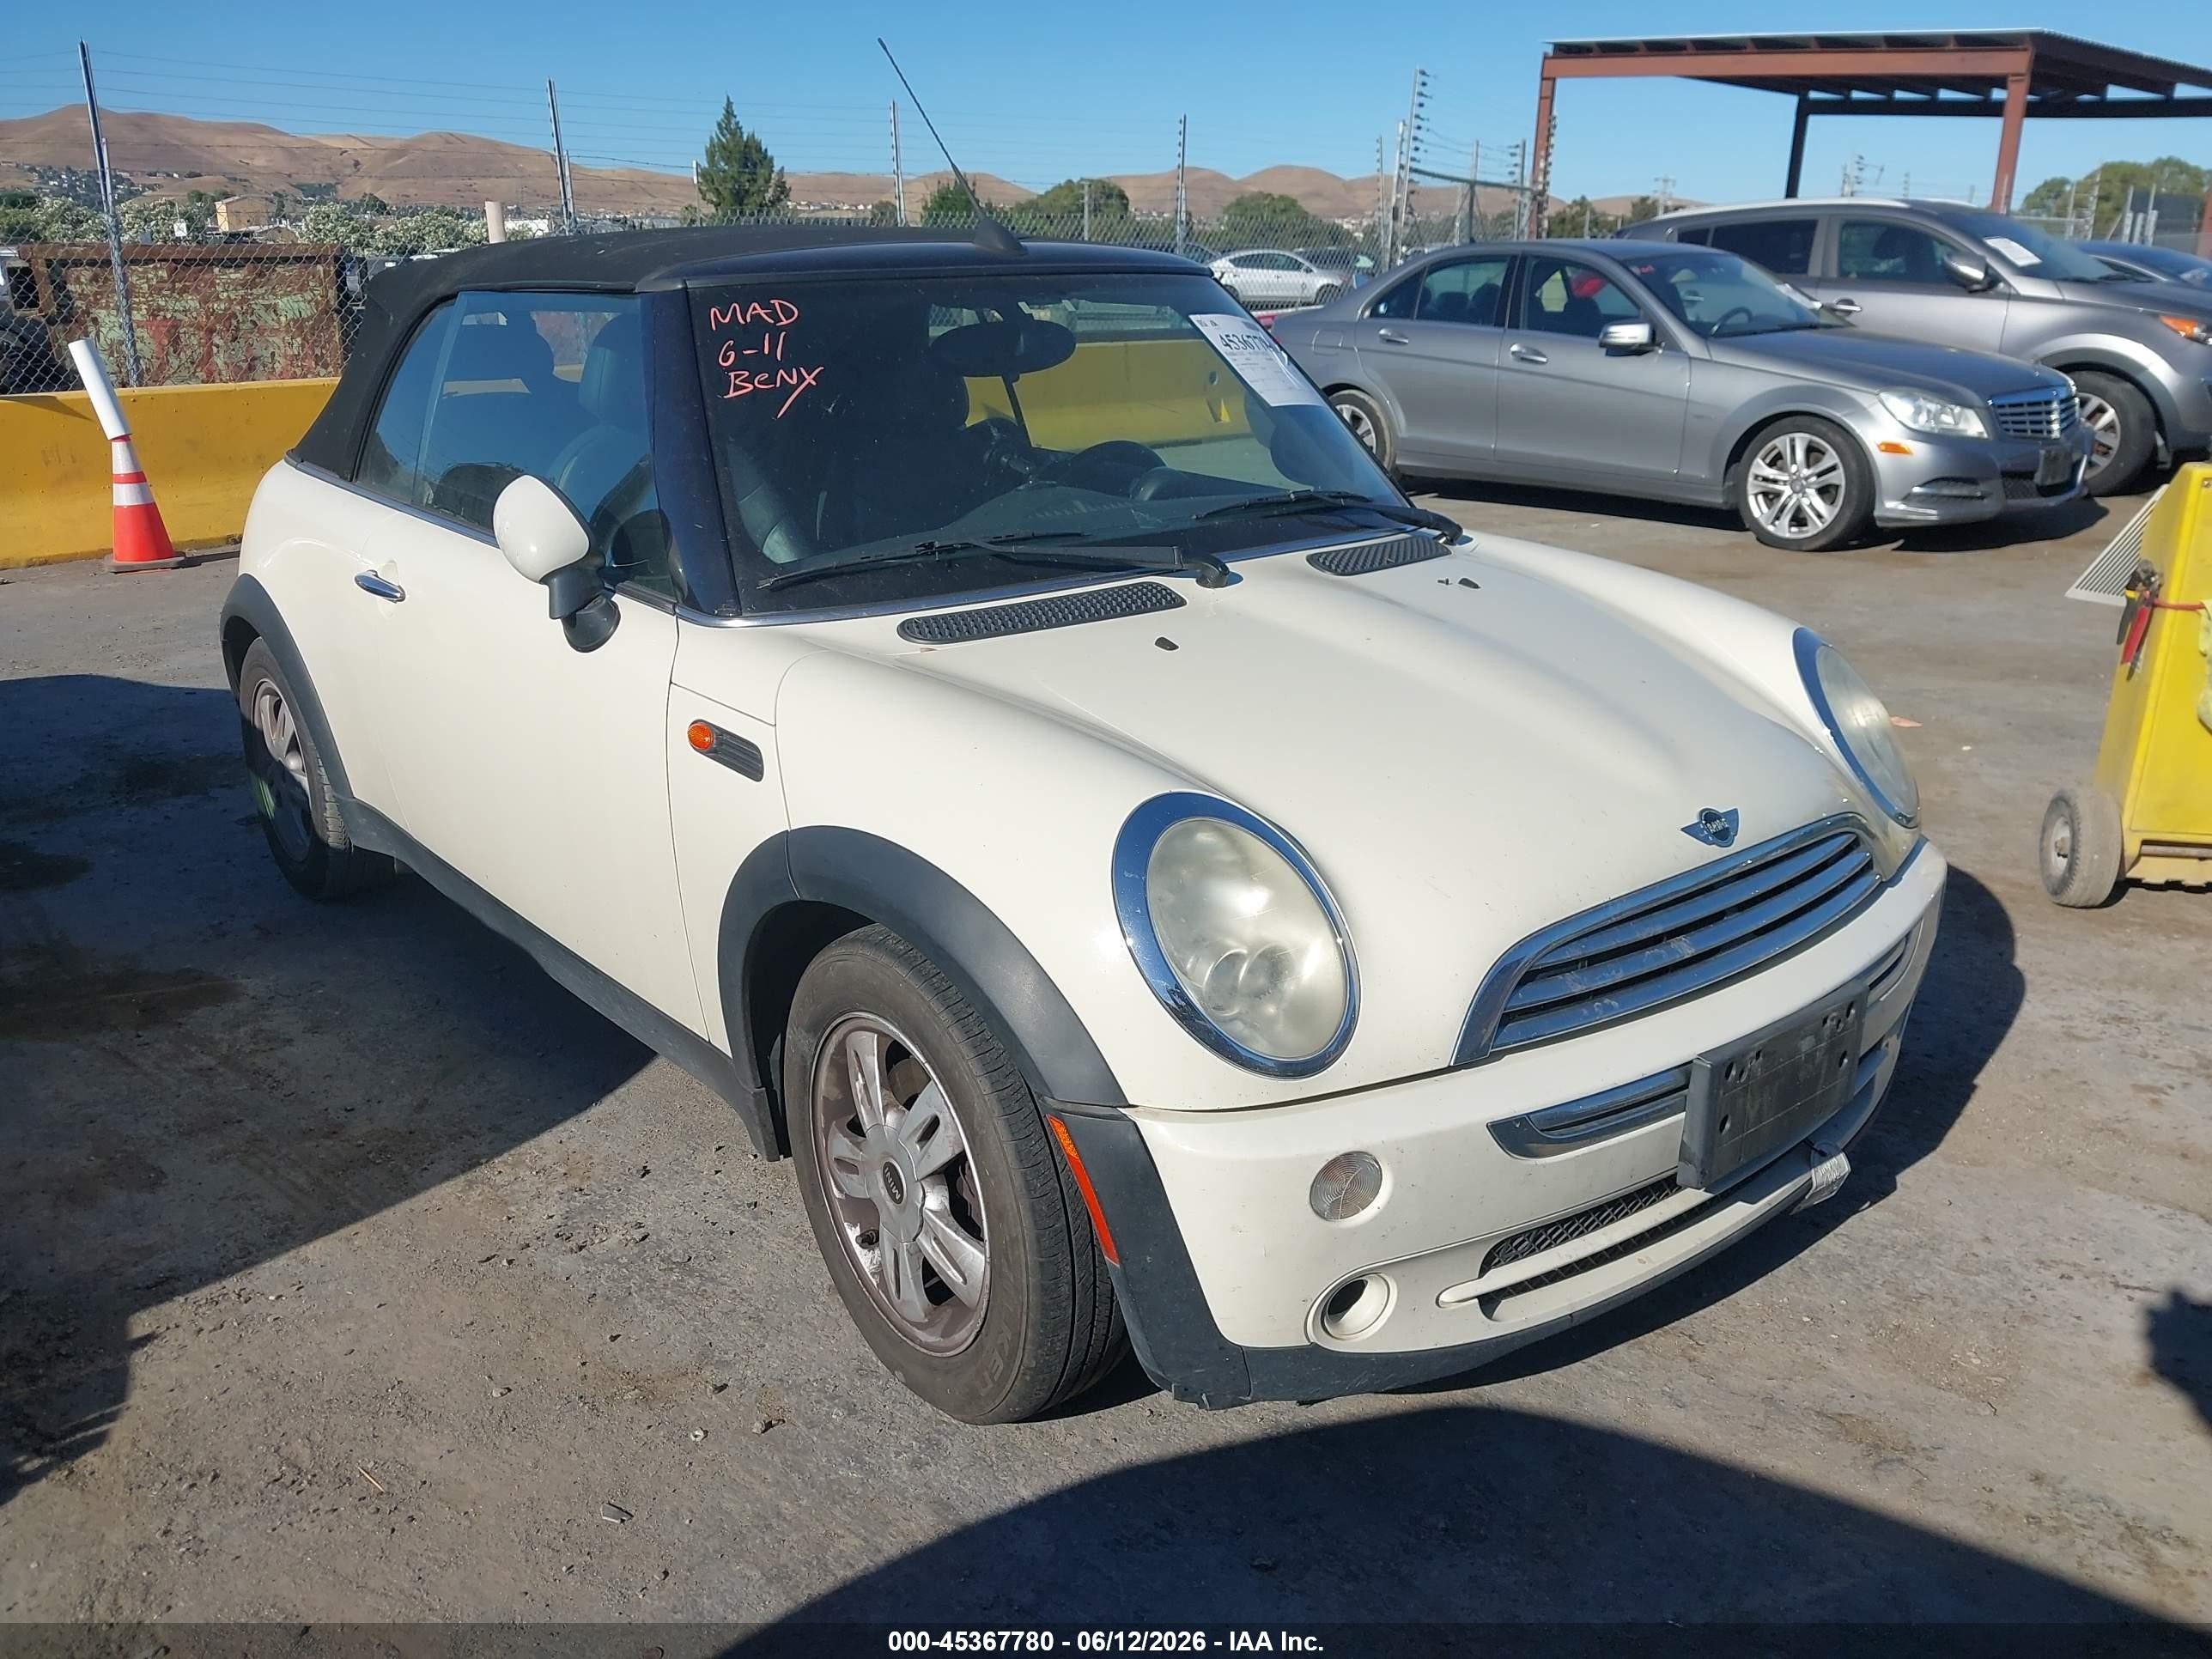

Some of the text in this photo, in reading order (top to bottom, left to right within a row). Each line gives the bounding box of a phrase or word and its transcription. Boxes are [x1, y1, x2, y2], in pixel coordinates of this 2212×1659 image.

[710, 300, 799, 331] MAD
[719, 331, 787, 367] 6-11
[1218, 333, 1277, 352] 453677
[884, 1167, 902, 1200] MINI
